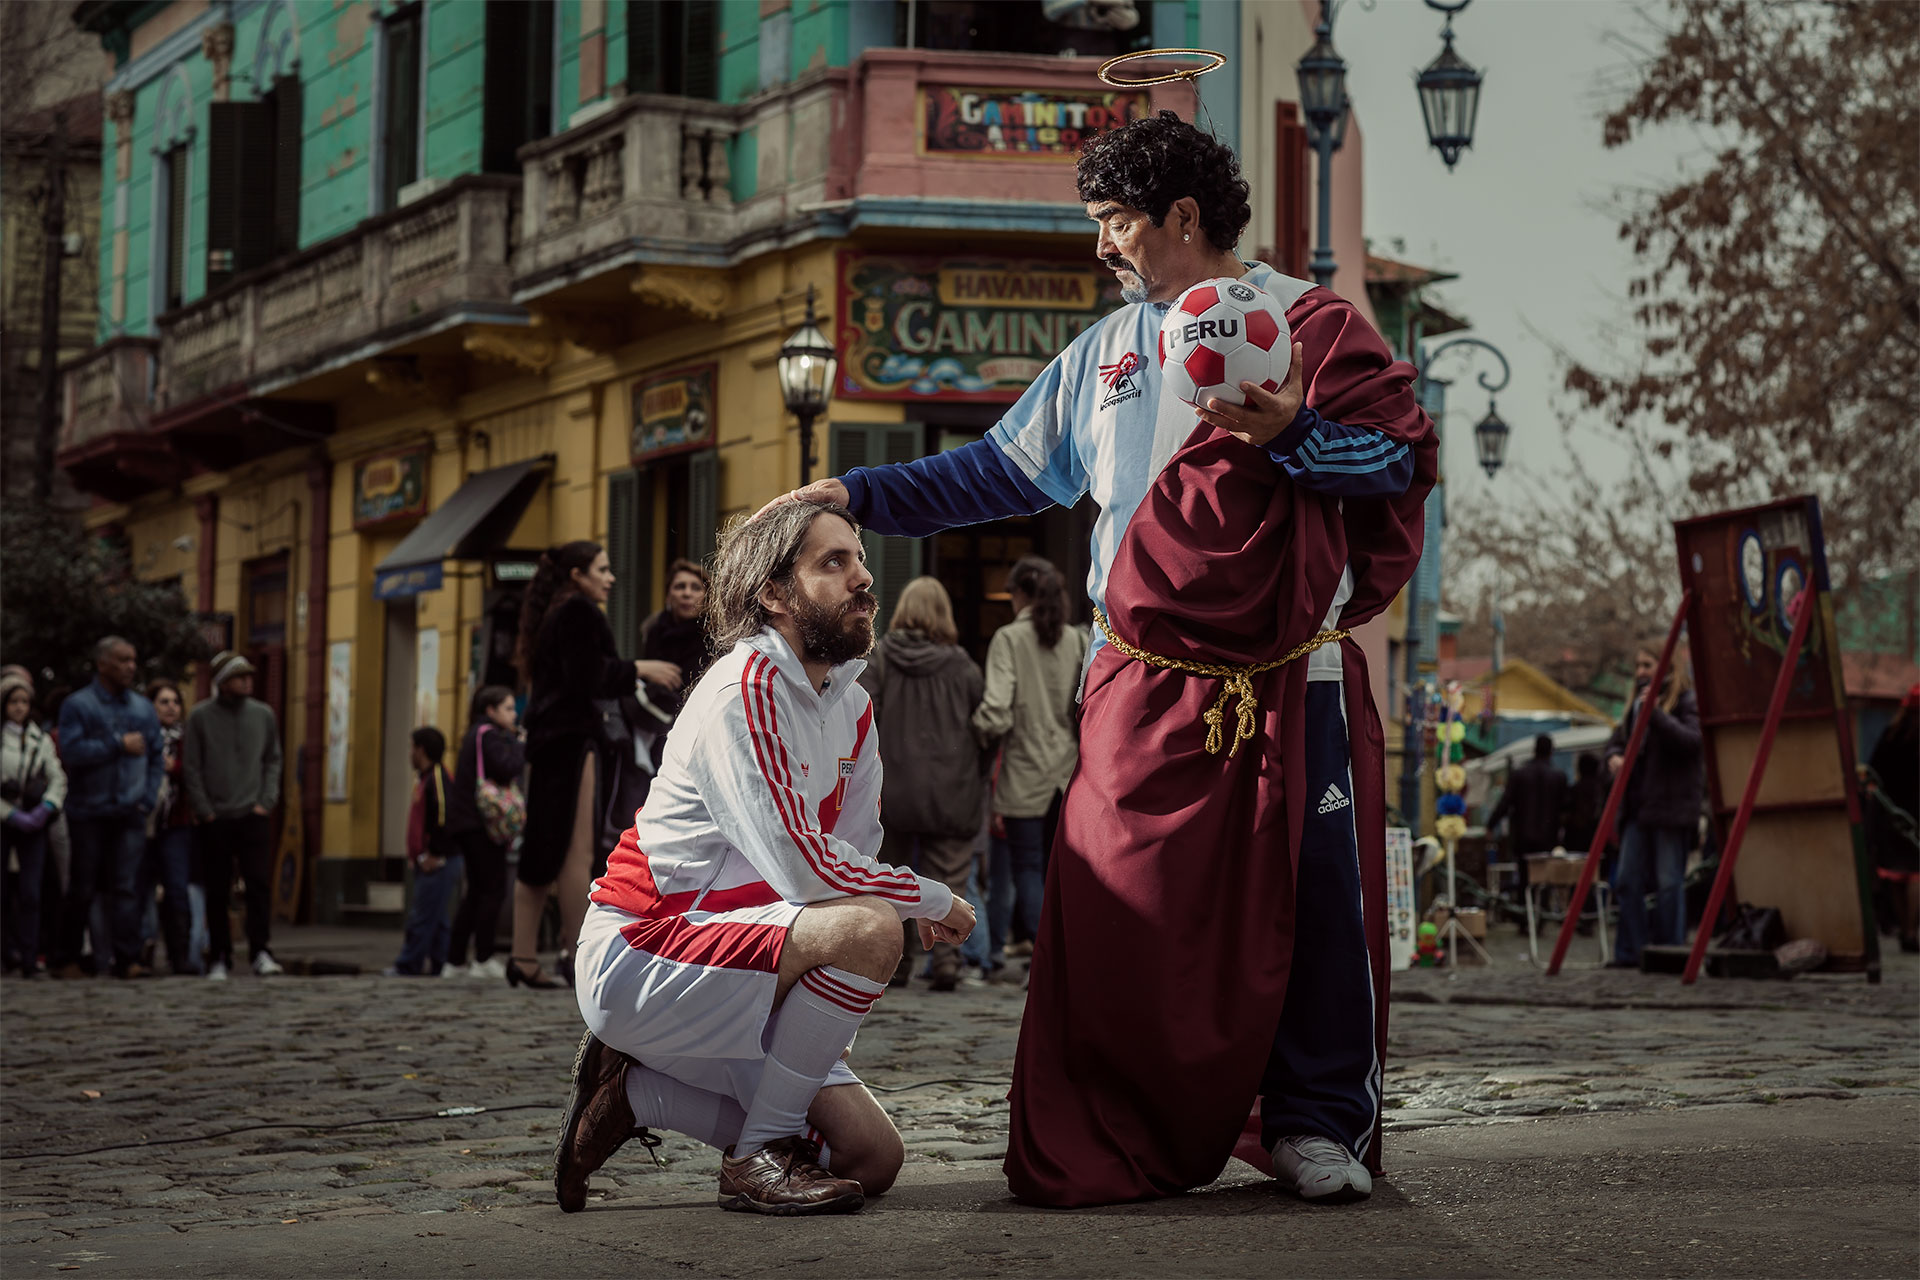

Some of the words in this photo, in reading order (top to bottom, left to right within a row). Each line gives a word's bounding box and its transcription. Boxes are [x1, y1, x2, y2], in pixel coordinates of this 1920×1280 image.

[955, 275, 1083, 303] HAVANNA
[894, 302, 1112, 354] CAMINIT
[1169, 319, 1238, 349] PERU
[1318, 797, 1349, 814] adidas
